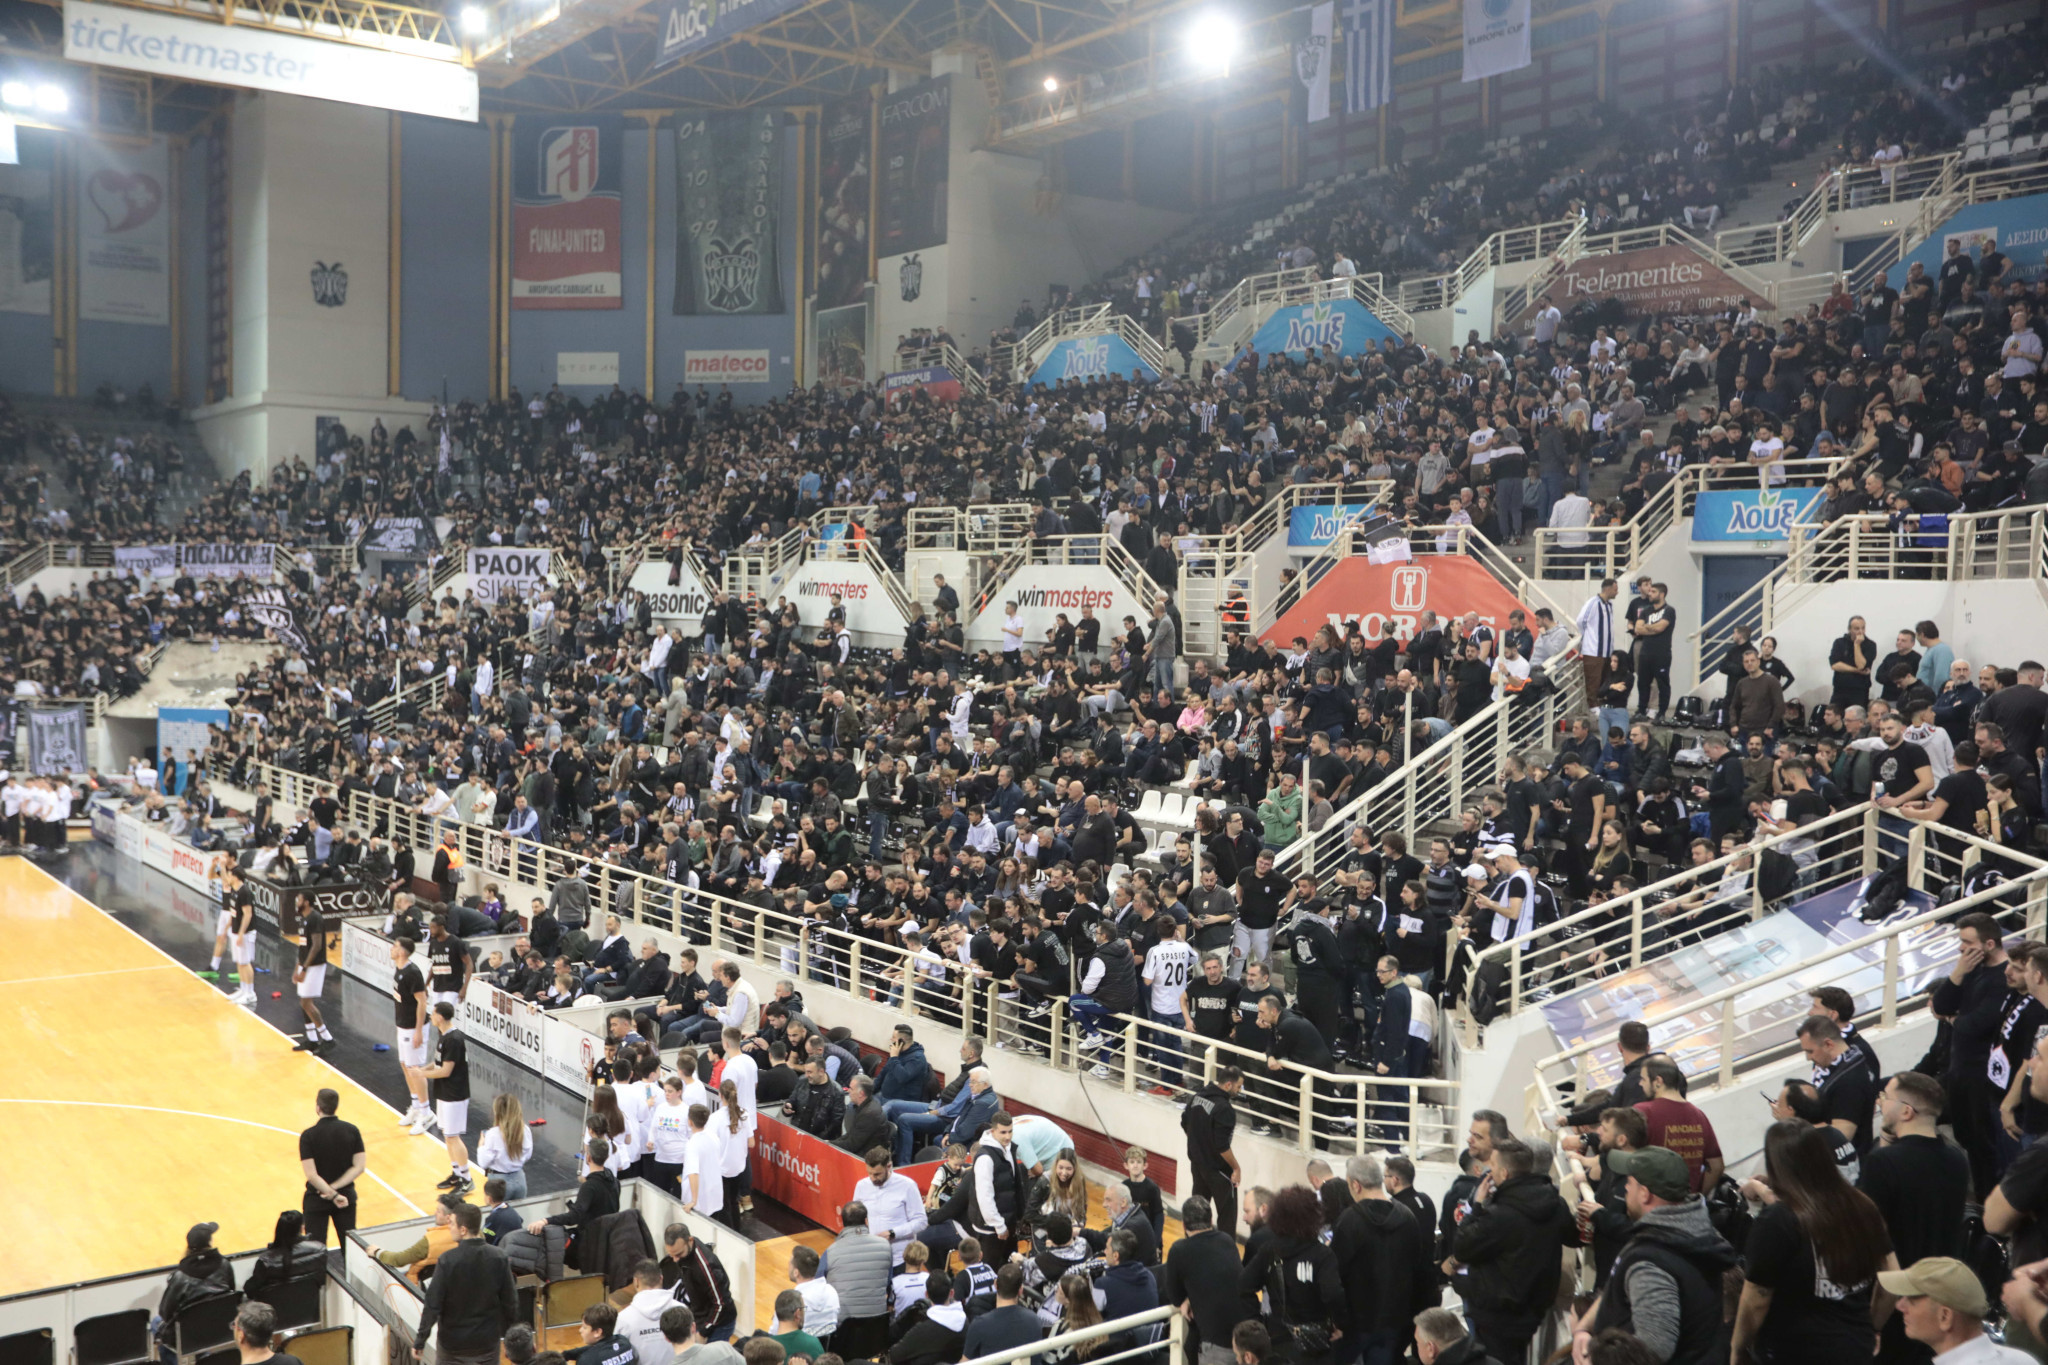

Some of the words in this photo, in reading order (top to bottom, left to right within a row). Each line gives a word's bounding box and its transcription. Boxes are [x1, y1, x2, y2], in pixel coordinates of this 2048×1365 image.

[1507, 21, 1525, 35] CUP
[69, 16, 315, 82] ticketmaster
[881, 87, 948, 127] FARCOM
[1564, 262, 1702, 297] Tselementes
[1285, 312, 1345, 353] λουξ
[686, 354, 767, 373] mateco
[1064, 344, 1108, 378] λουξ
[887, 370, 932, 388] METROPOLIS
[1727, 498, 1798, 537] λουξ
[474, 553, 543, 577] PAOK
[799, 577, 868, 599] winmasters
[1018, 584, 1113, 609] winmasters
[1160, 952, 1186, 961] SPASIC
[1164, 962, 1184, 987] 20
[466, 1001, 540, 1053] SIDIROPOULOS
[1667, 1124, 1703, 1134] VANDALS
[1667, 1137, 1704, 1147] VANDALS
[759, 1135, 820, 1187] infotrust
